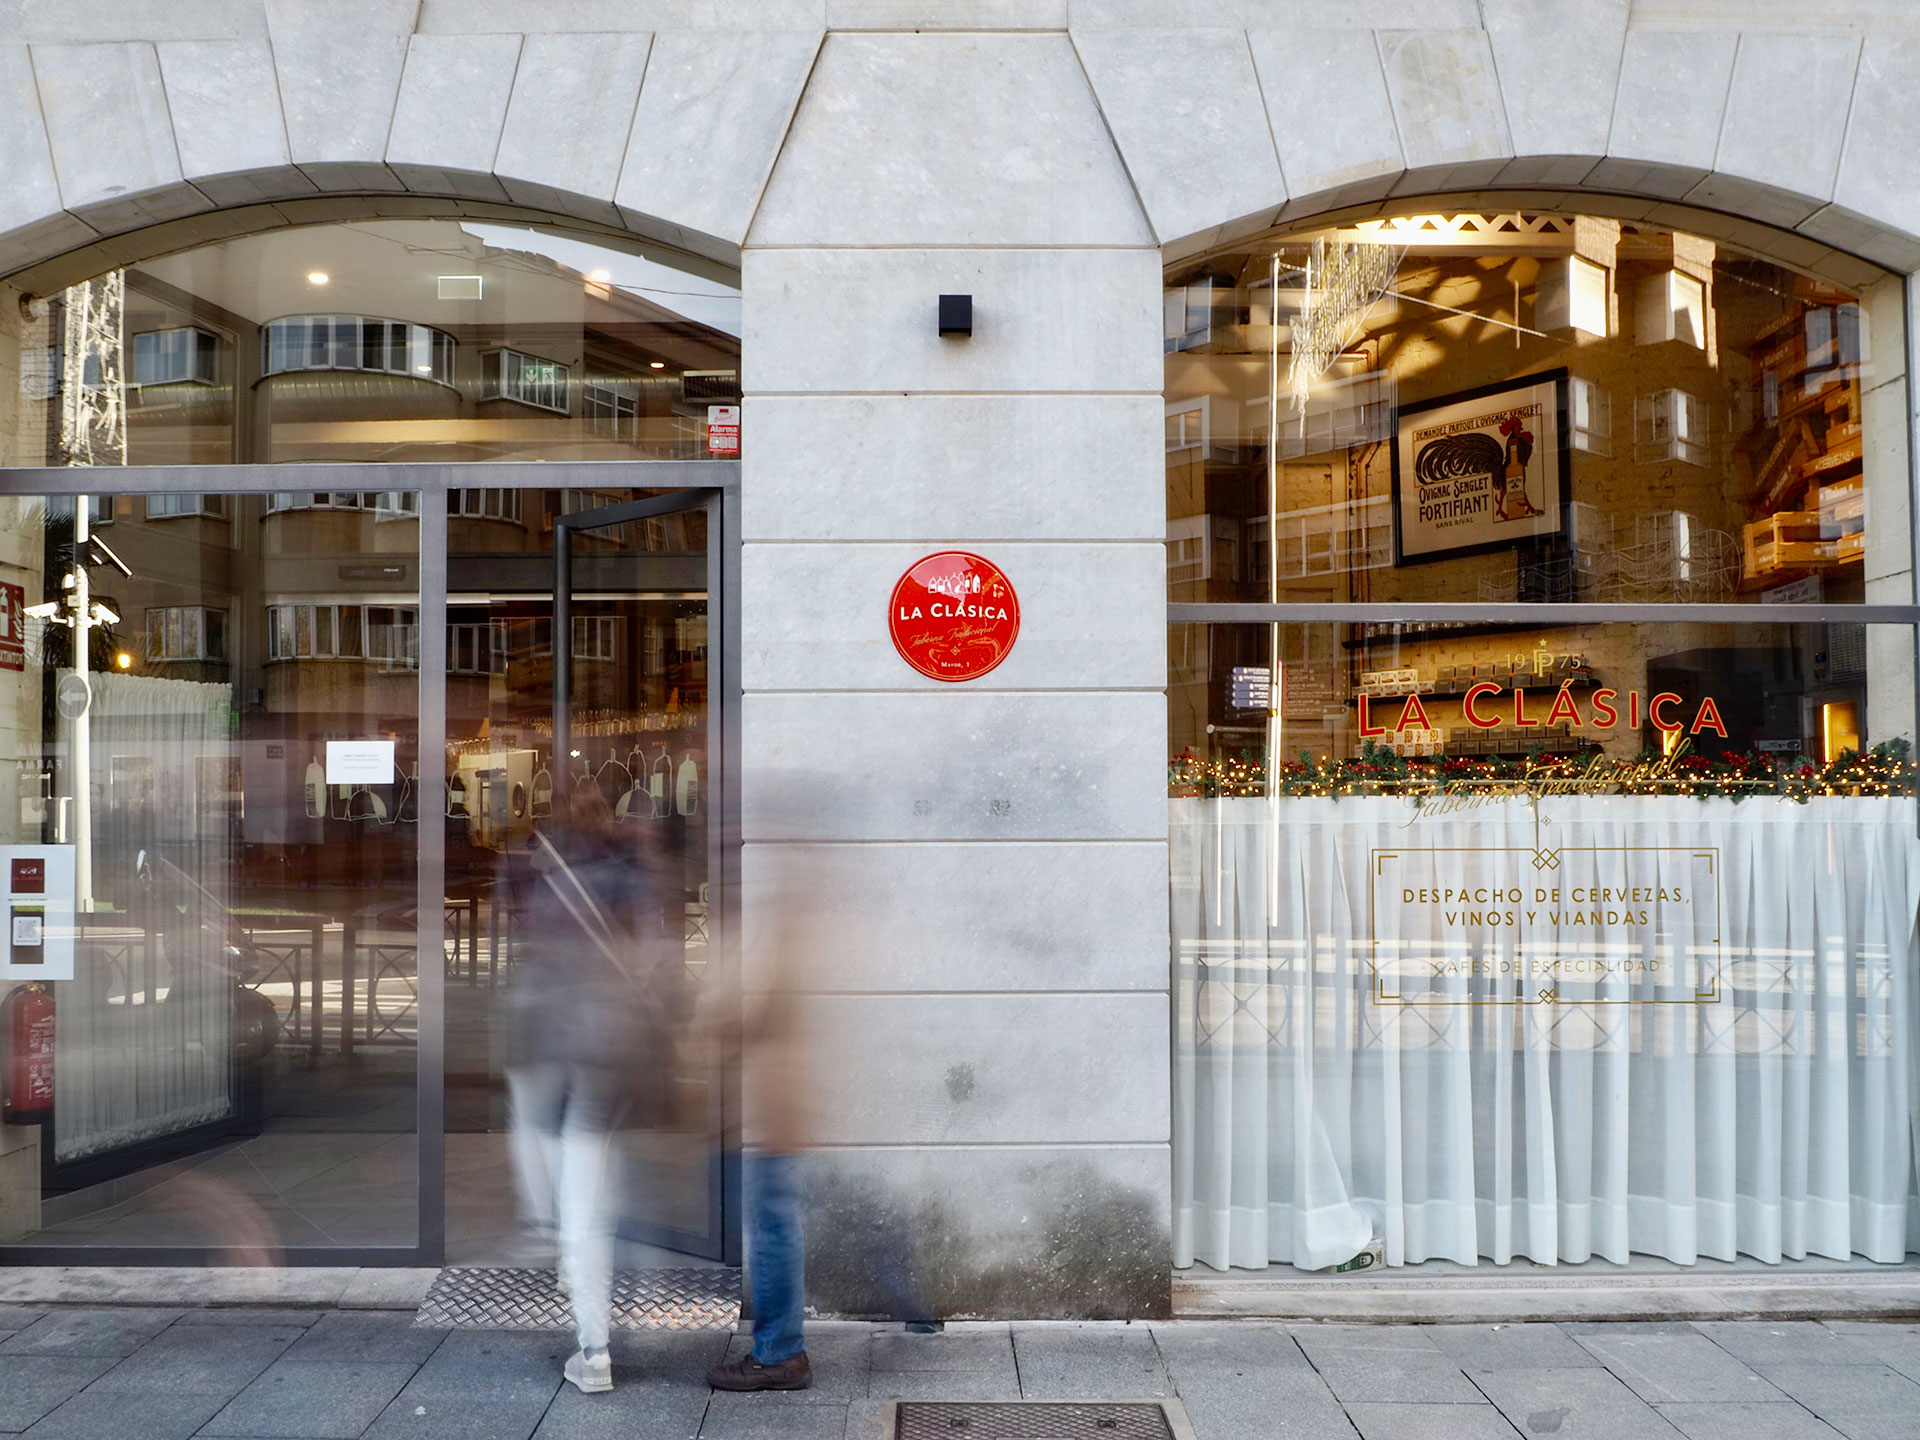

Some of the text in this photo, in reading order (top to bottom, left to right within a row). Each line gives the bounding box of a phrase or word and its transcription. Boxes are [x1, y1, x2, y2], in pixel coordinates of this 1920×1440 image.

[1416, 428, 1447, 441] DEMANDEZ
[1449, 420, 1474, 433] PARTOUT
[1509, 405, 1539, 419] SENGLET
[1419, 483, 1451, 504] OVIGNAC
[1453, 477, 1489, 498] SENGLET
[1419, 494, 1490, 523] FORTIFIANT
[1435, 517, 1474, 530] SANS RIVAL
[900, 601, 1008, 621] LA CLÁSICA
[1505, 653, 1526, 669] 19
[1559, 653, 1582, 669] 75
[1357, 692, 1432, 739] LA
[1463, 678, 1729, 739] CLÁSICA
[1398, 736, 1692, 830] Taberna Tradicional
[1402, 887, 1691, 905] DESPACHO DE CERVEZAS,
[1445, 910, 1649, 927] VINOS Y VIANDAS
[1434, 958, 1661, 974] CAFÉS DE ESPECIALIDAD
